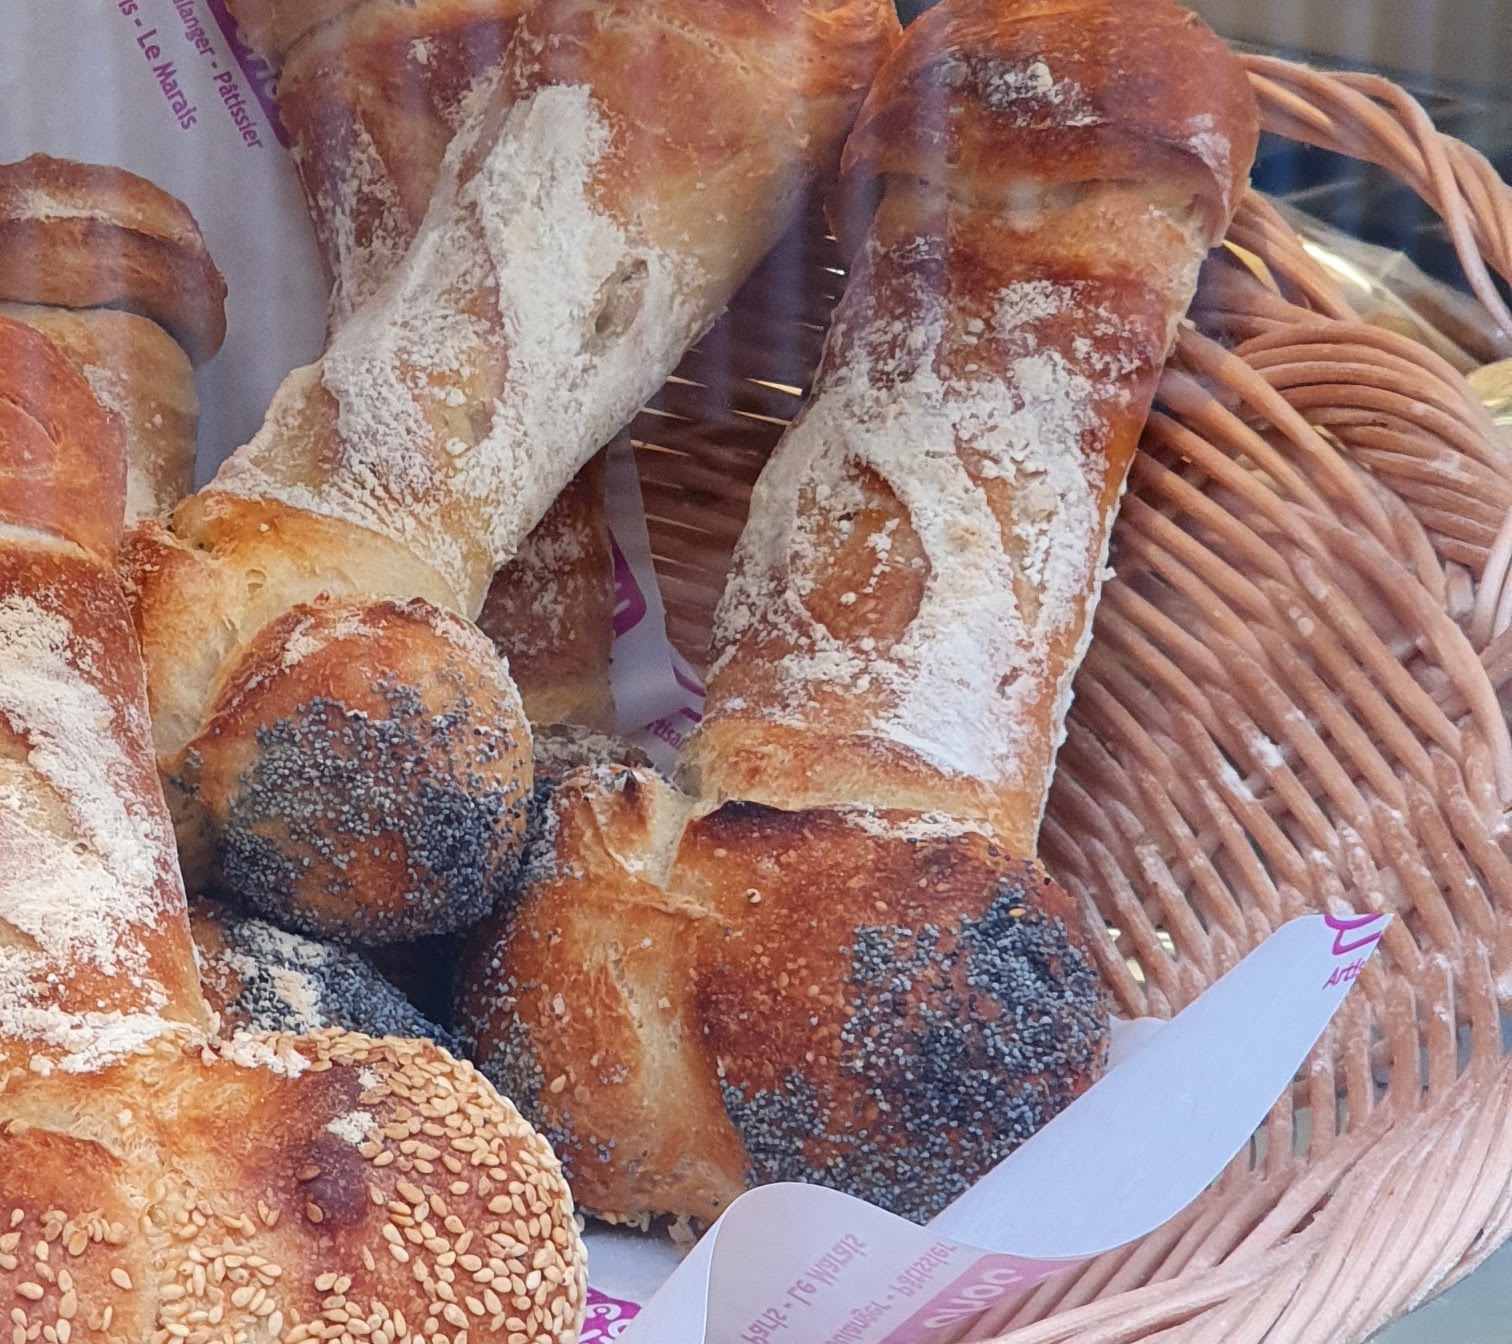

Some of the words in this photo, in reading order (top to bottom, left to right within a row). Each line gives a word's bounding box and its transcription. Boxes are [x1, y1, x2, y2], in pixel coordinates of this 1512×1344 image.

[136, 28, 162, 61] Le
[152, 61, 199, 131] Marais
[213, 71, 263, 149] Pâtissier
